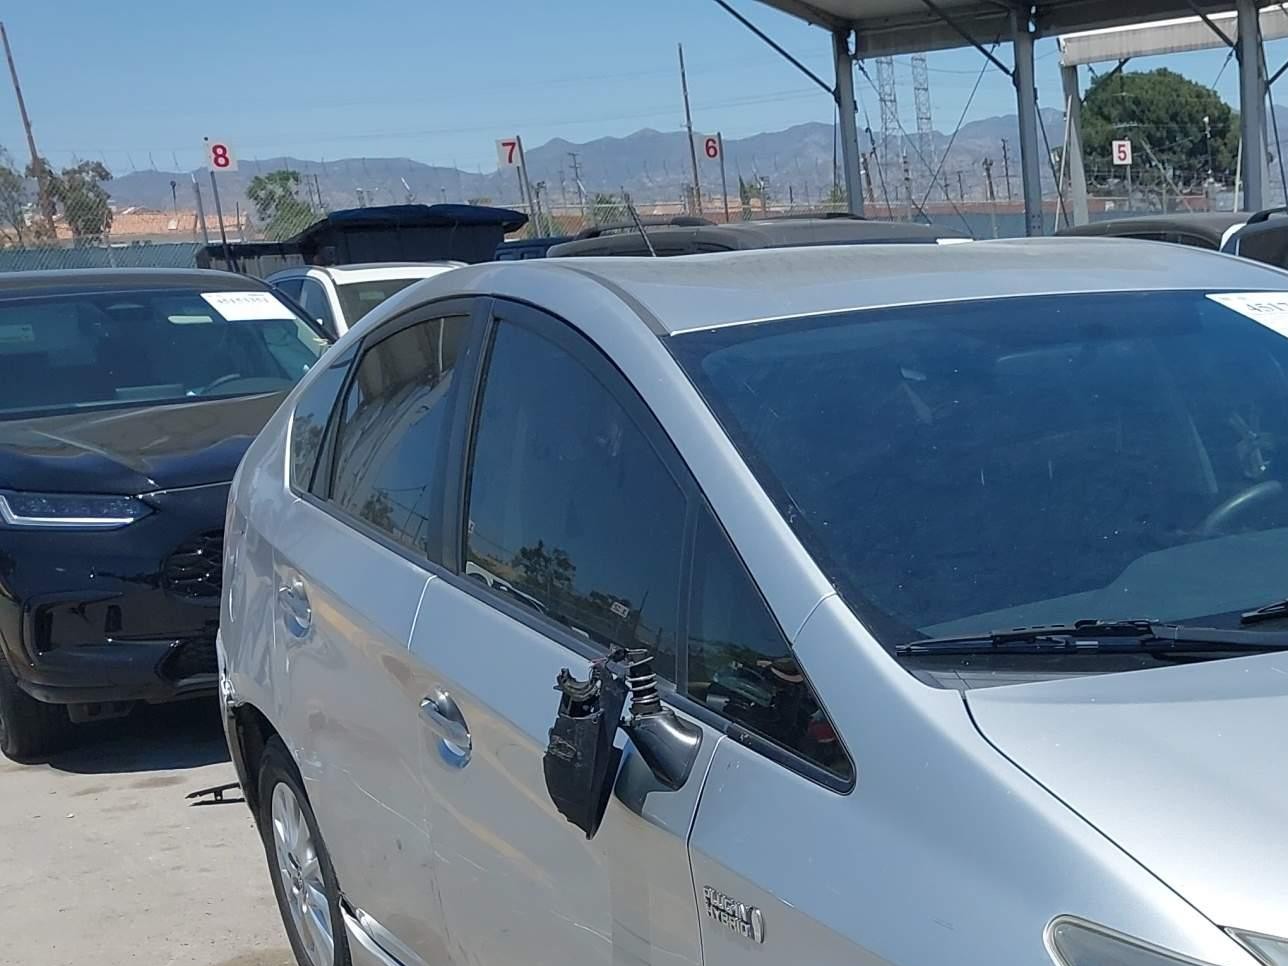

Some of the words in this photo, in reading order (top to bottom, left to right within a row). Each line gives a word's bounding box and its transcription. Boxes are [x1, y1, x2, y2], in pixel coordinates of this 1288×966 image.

[211, 144, 230, 168] 8
[501, 142, 517, 164] 7
[705, 138, 718, 158] 6
[1117, 143, 1127, 161] 5
[705, 904, 751, 937] HYBRID
